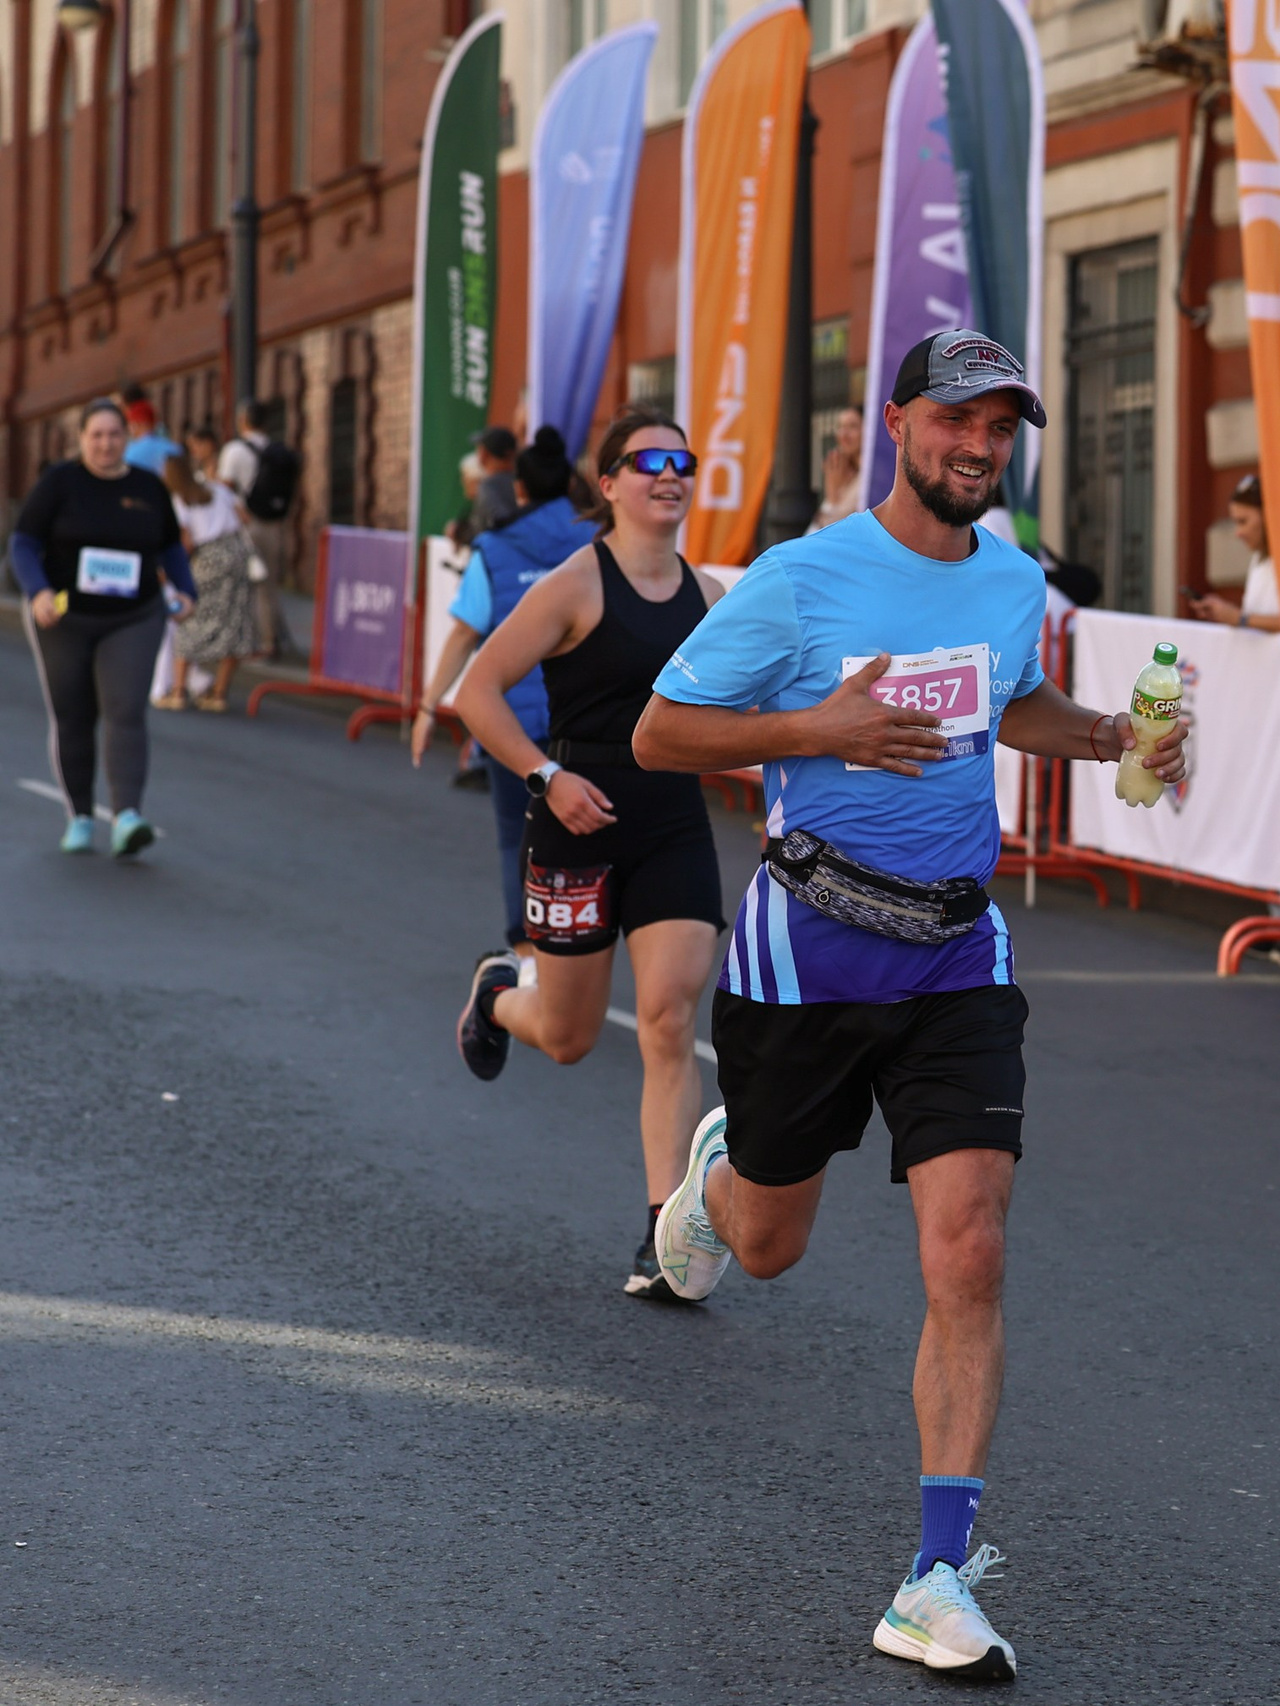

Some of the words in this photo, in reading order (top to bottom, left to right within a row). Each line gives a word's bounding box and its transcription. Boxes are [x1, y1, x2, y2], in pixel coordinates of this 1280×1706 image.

[976, 349, 1000, 364] NY
[876, 677, 962, 713] 3857
[526, 897, 599, 928] 084
